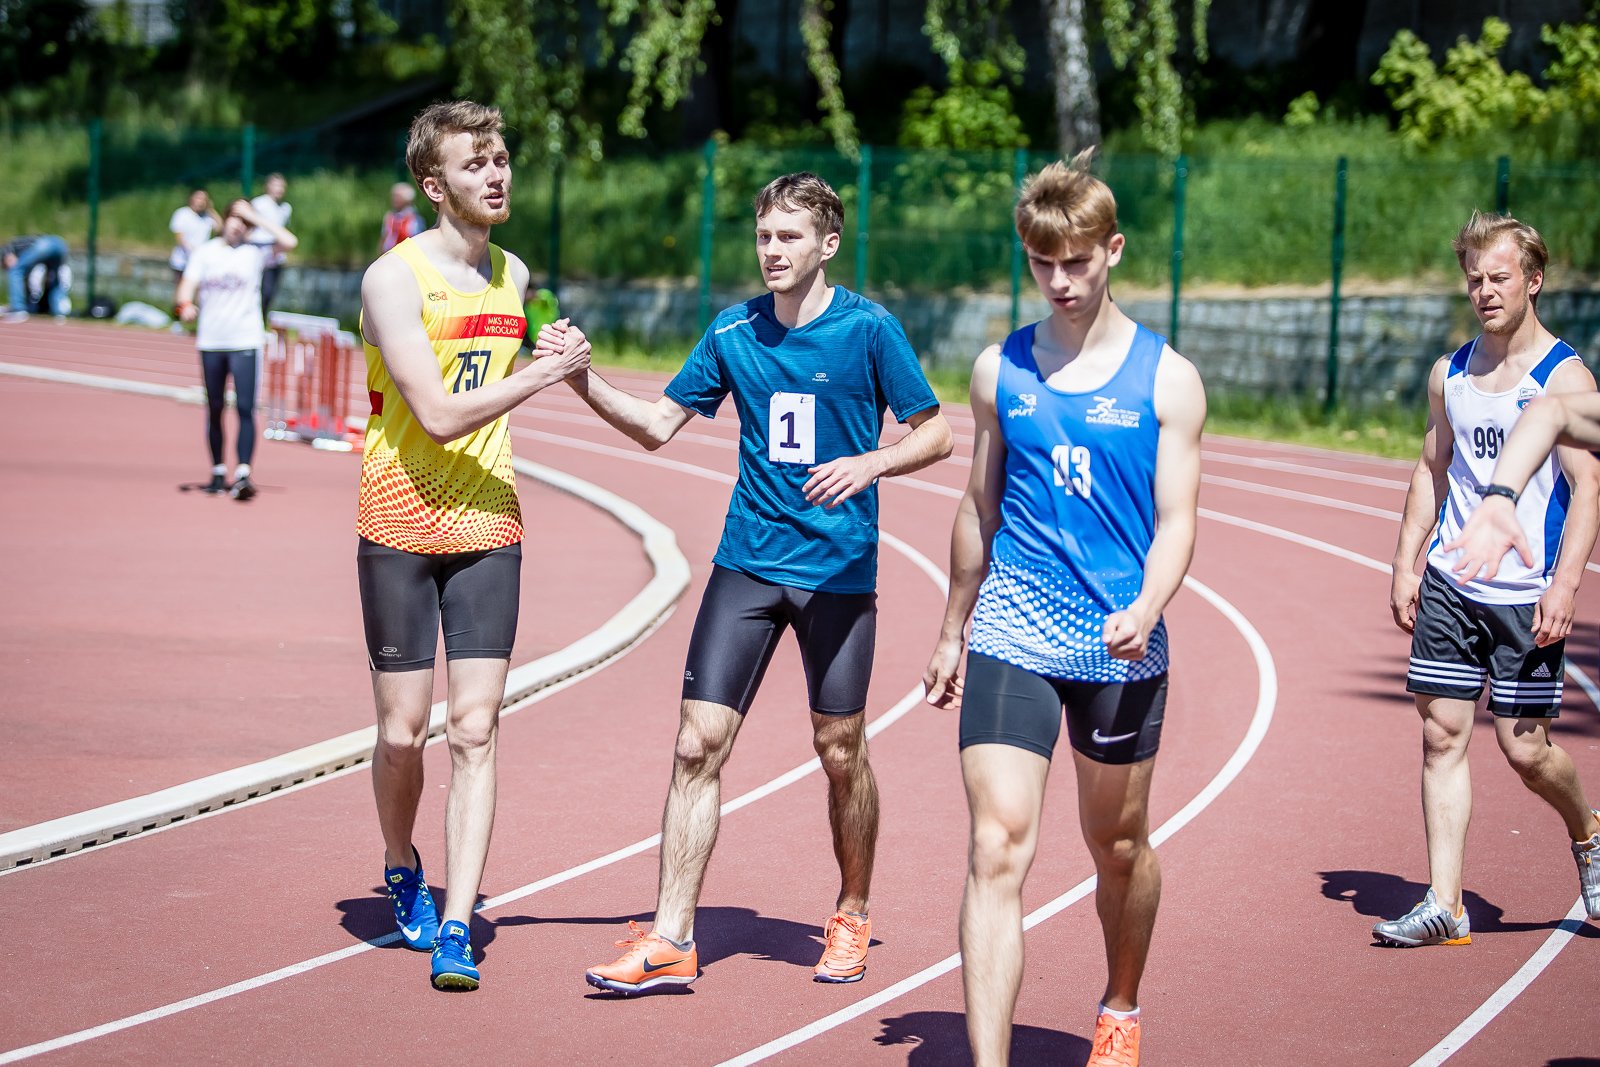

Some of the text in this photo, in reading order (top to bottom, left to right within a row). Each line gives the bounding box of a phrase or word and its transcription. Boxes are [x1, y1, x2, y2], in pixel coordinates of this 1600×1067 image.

[484, 325, 519, 335] WROCŁAW
[487, 317, 519, 327] MKS MOS
[452, 350, 492, 394] 757
[780, 411, 801, 449] 1
[1473, 427, 1504, 460] 991
